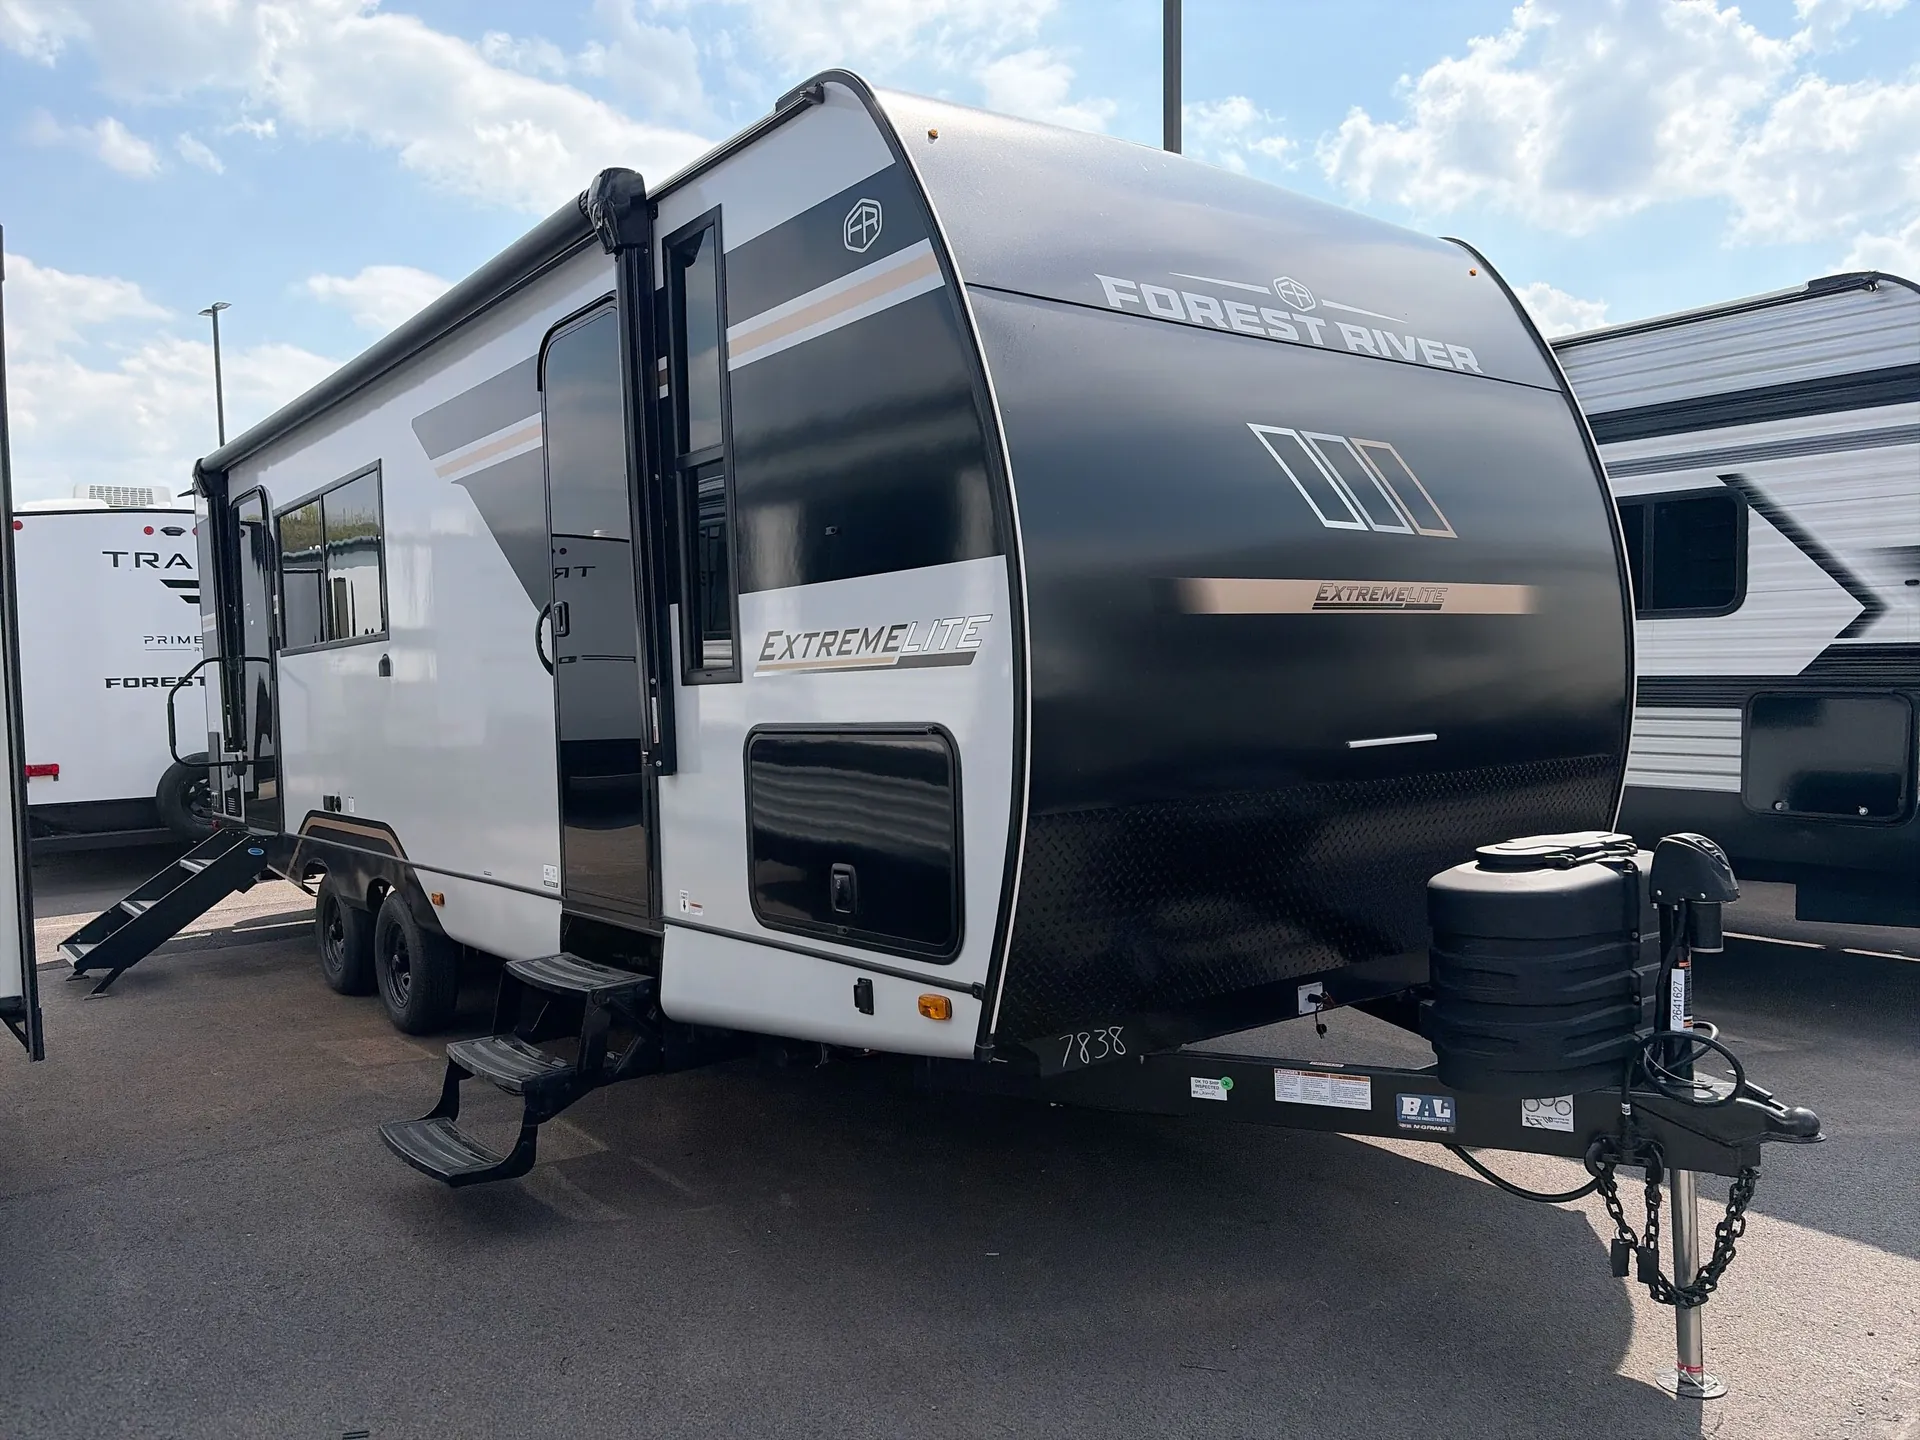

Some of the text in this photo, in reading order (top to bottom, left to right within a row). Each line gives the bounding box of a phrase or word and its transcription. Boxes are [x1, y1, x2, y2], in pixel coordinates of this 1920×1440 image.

[1094, 273, 1484, 374] FOREST RIVER
[102, 550, 194, 570] TRA
[143, 635, 204, 645] PRIME
[104, 676, 206, 689] FOREST
[1672, 980, 1683, 1022] 2641627
[1059, 1026, 1126, 1068] 7838
